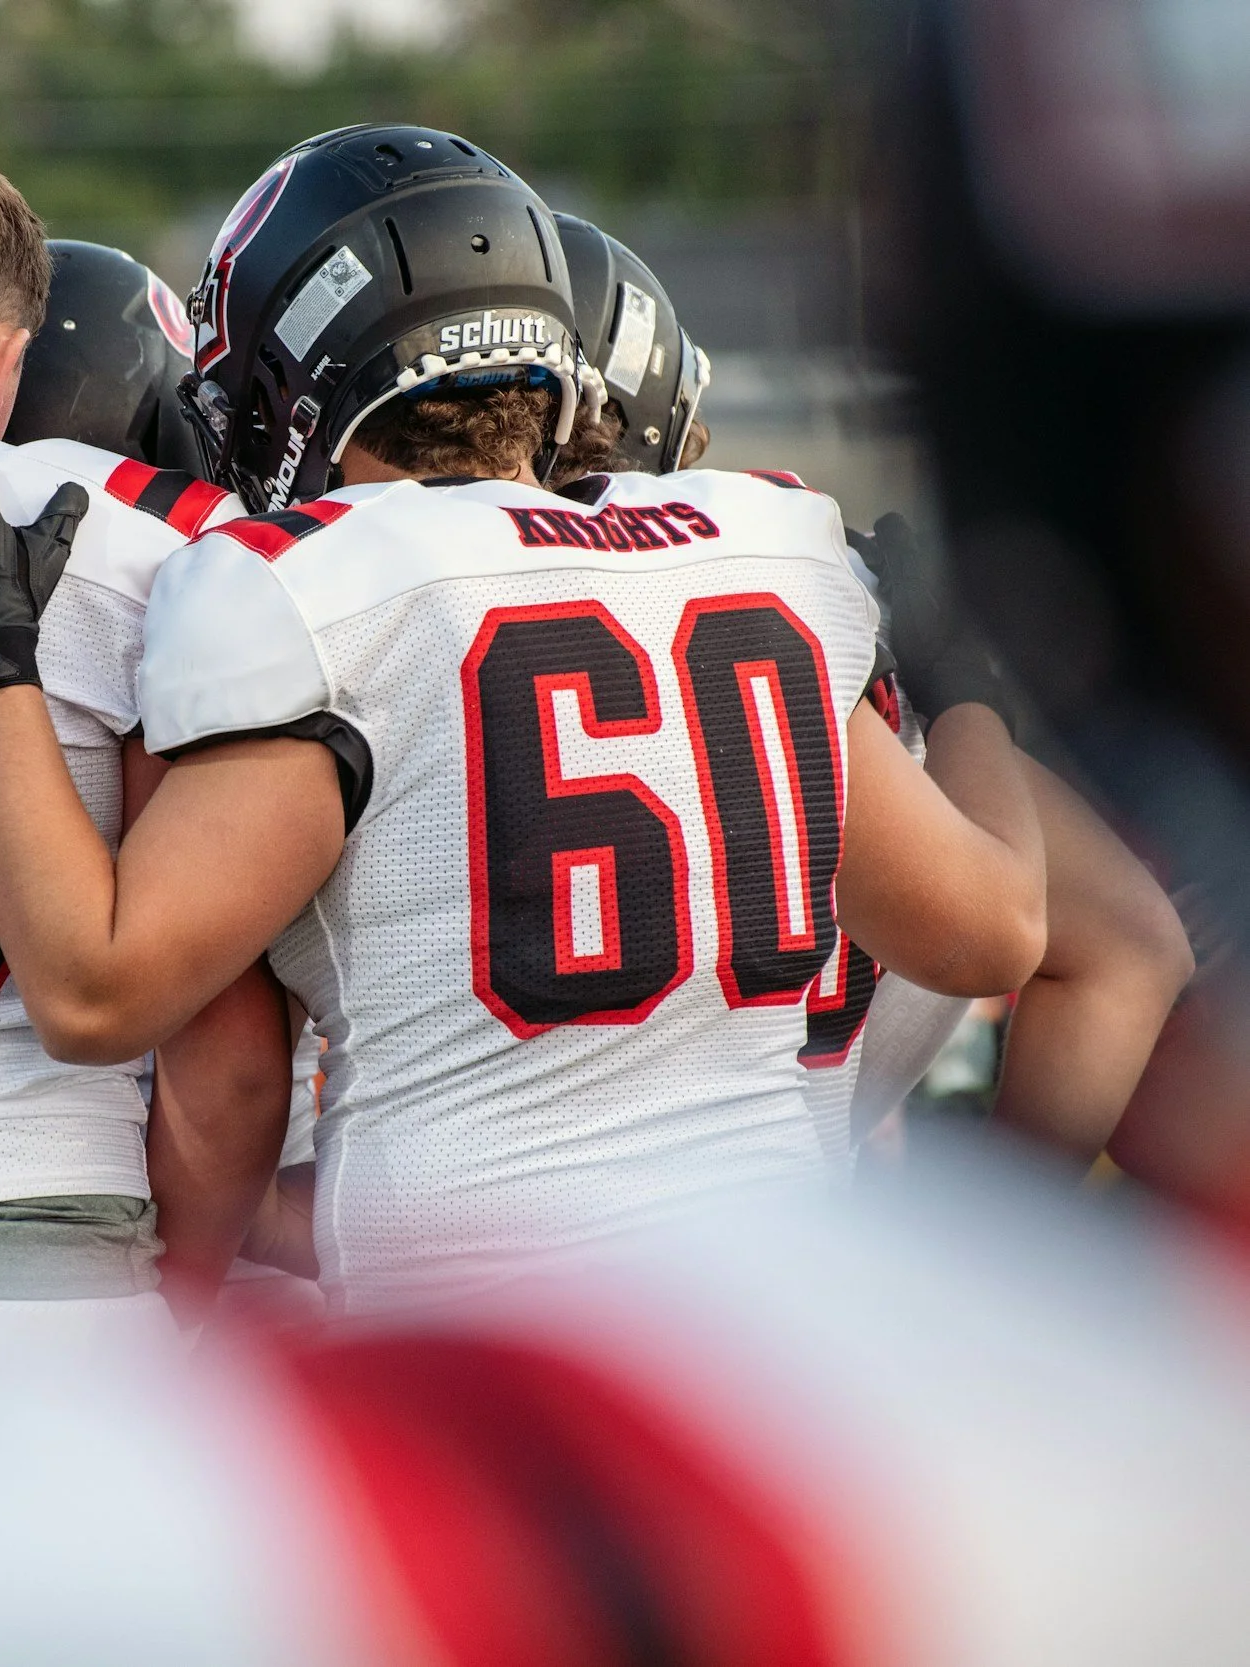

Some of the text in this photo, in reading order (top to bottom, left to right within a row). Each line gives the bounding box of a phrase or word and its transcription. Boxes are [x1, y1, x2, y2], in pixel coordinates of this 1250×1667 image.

[440, 311, 546, 352] schutt
[310, 354, 332, 381] X-LARGE
[499, 502, 720, 552] KNIGHTS
[460, 592, 846, 1041] 60
